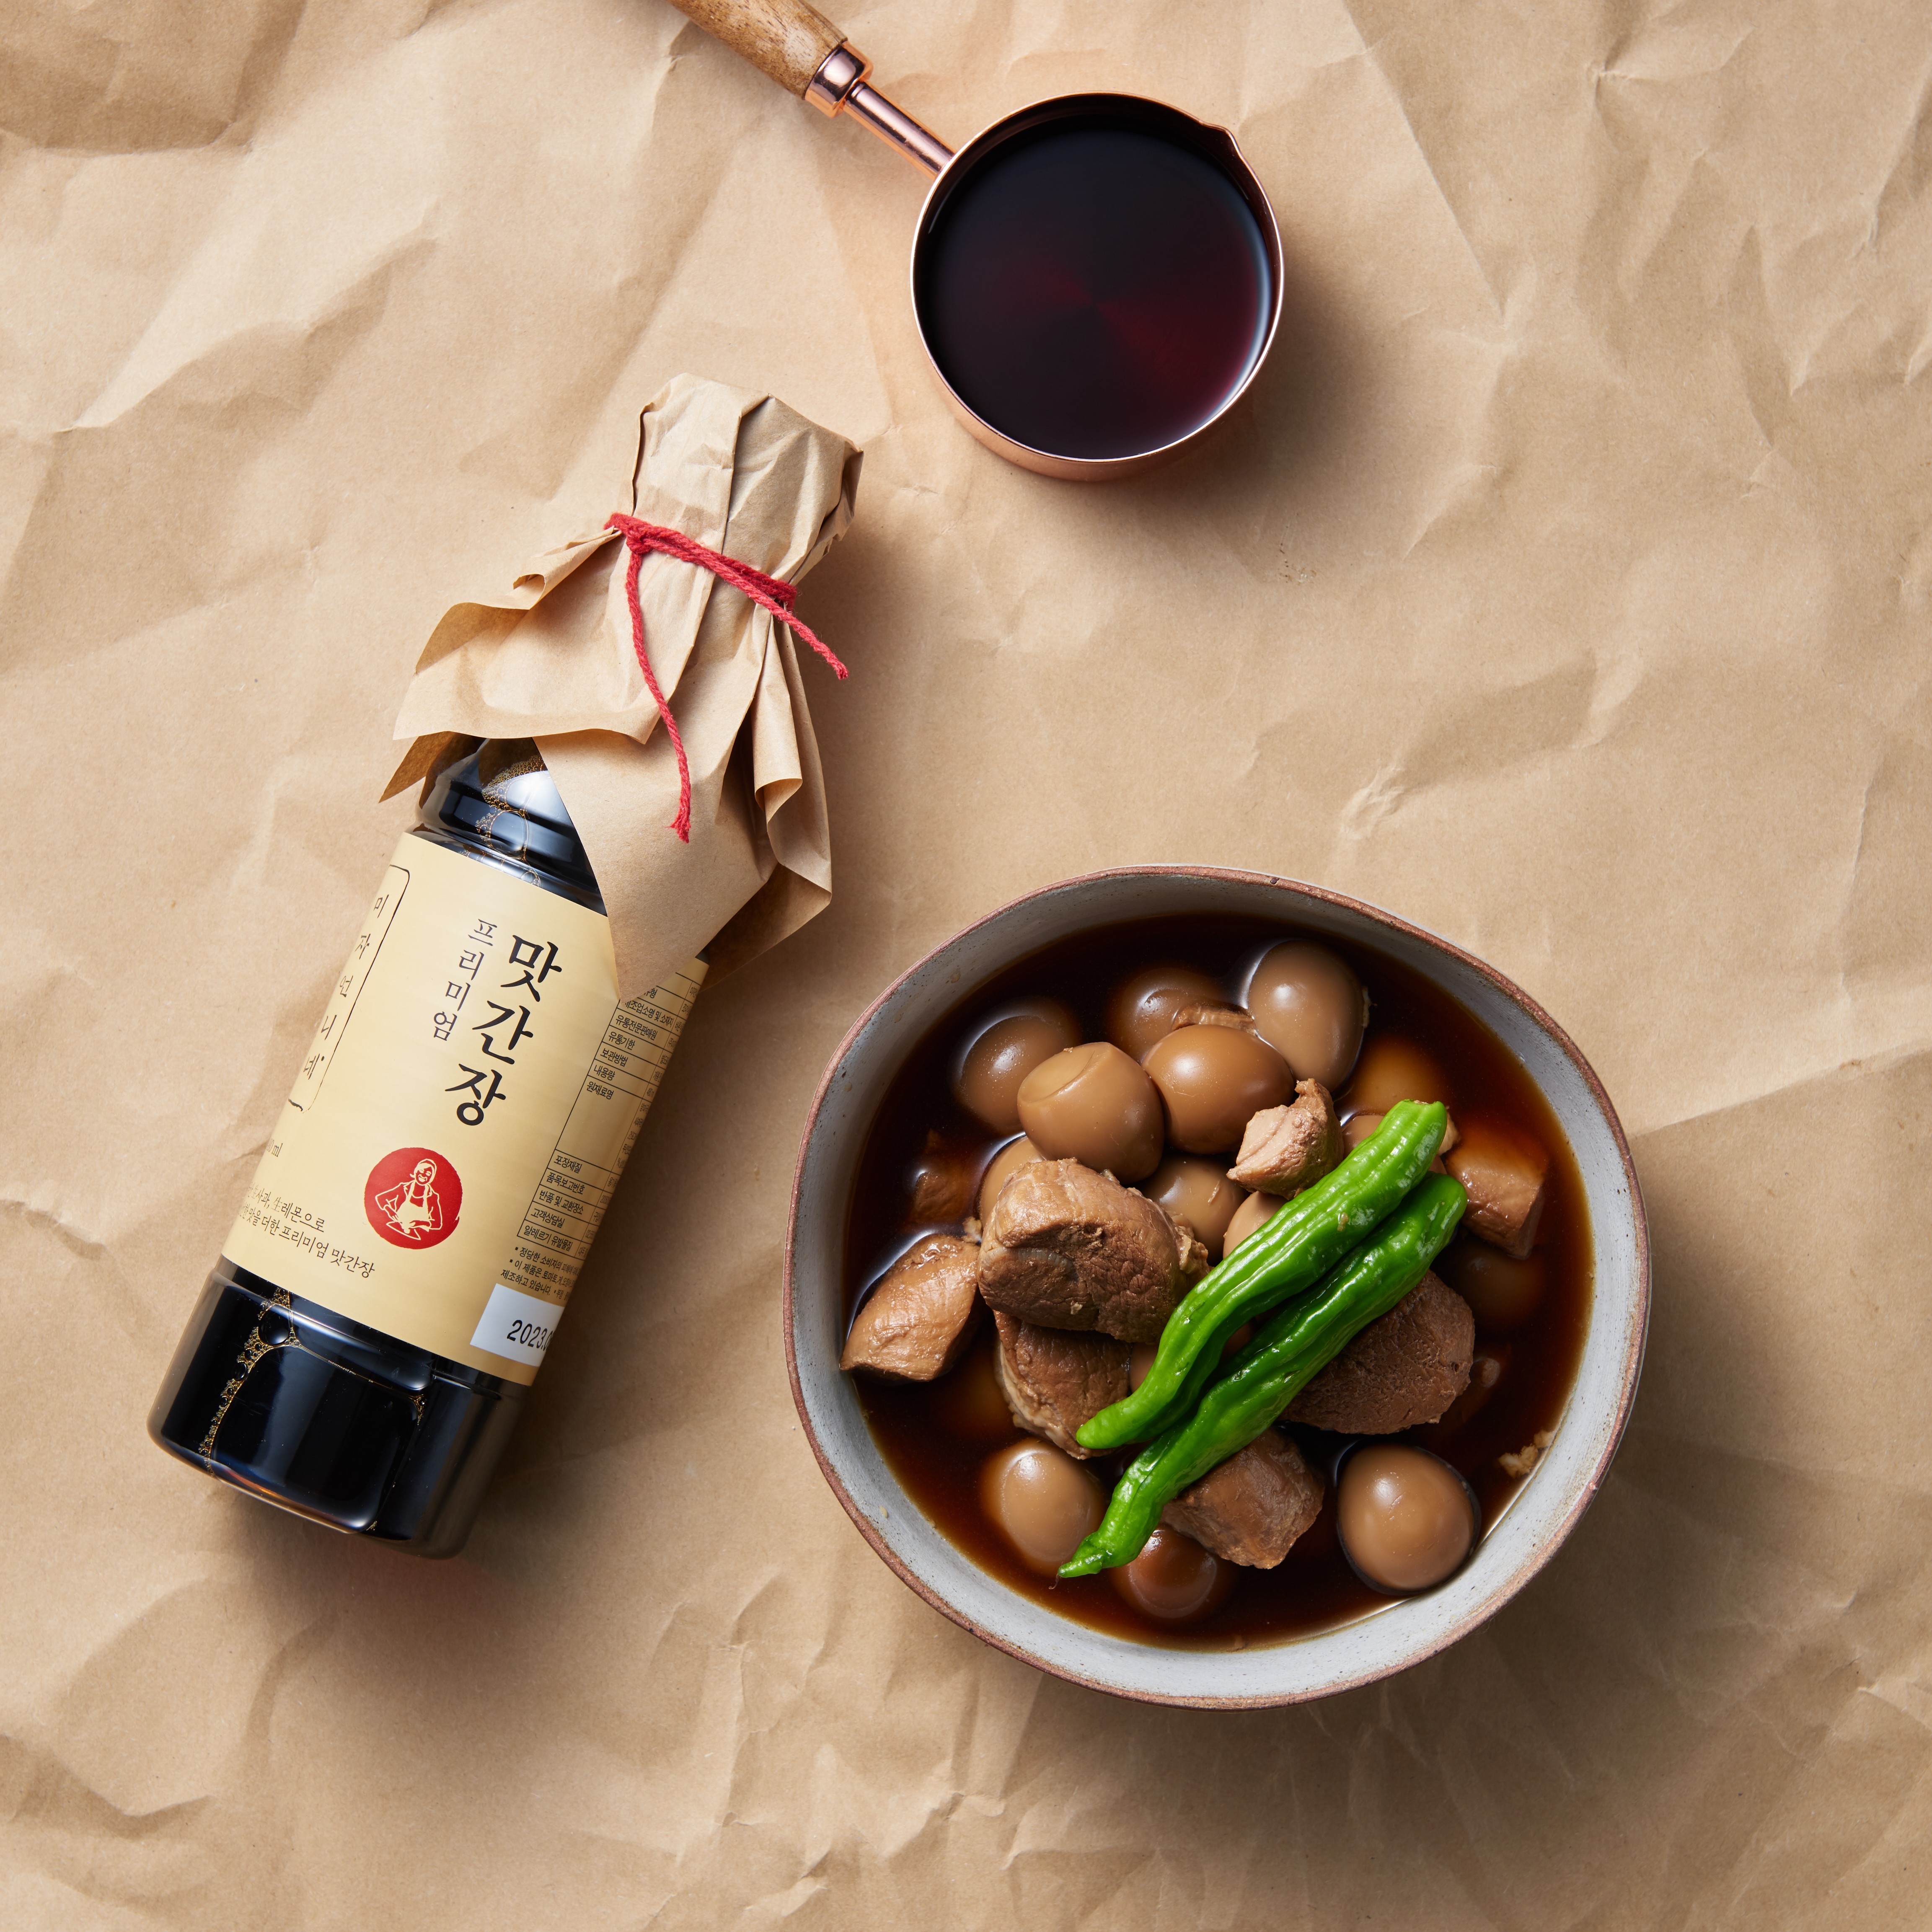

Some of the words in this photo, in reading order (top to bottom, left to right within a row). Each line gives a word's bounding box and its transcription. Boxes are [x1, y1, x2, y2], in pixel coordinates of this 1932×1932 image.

[434, 918, 497, 1041] 프리미엄
[445, 935, 562, 1125] 맛간장
[616, 1015, 658, 1040] 유통전문판매원
[654, 1011, 661, 1021] 및
[660, 1014, 674, 1027] 소재지
[608, 1032, 635, 1050] 유통기한
[600, 1048, 628, 1067] 보관방법
[594, 1065, 615, 1081] 내용량
[587, 1081, 614, 1100] 원재료명
[554, 1156, 582, 1173] 포장재질
[546, 1172, 585, 1195] 품목보고번호
[539, 1190, 555, 1203] 반품
[554, 1195, 562, 1205] 및
[561, 1199, 583, 1215] 교환장소
[271, 1197, 325, 1233] 生레몬으로
[531, 1208, 565, 1228] 고객상담실
[261, 1216, 280, 1236] 더한
[279, 1226, 329, 1258] 프리미엄
[331, 1249, 375, 1278] 맛간장
[524, 1226, 552, 1243] 알레르기
[551, 1236, 573, 1252] 유발물질
[515, 1260, 522, 1270] 이
[522, 1264, 542, 1277] 제품은
[520, 1247, 540, 1262] 정당한
[540, 1256, 563, 1270] 소비자의
[501, 1270, 529, 1286] 제조하고
[528, 1280, 551, 1295] 있습니다.
[507, 1320, 553, 1351] 2023.0
